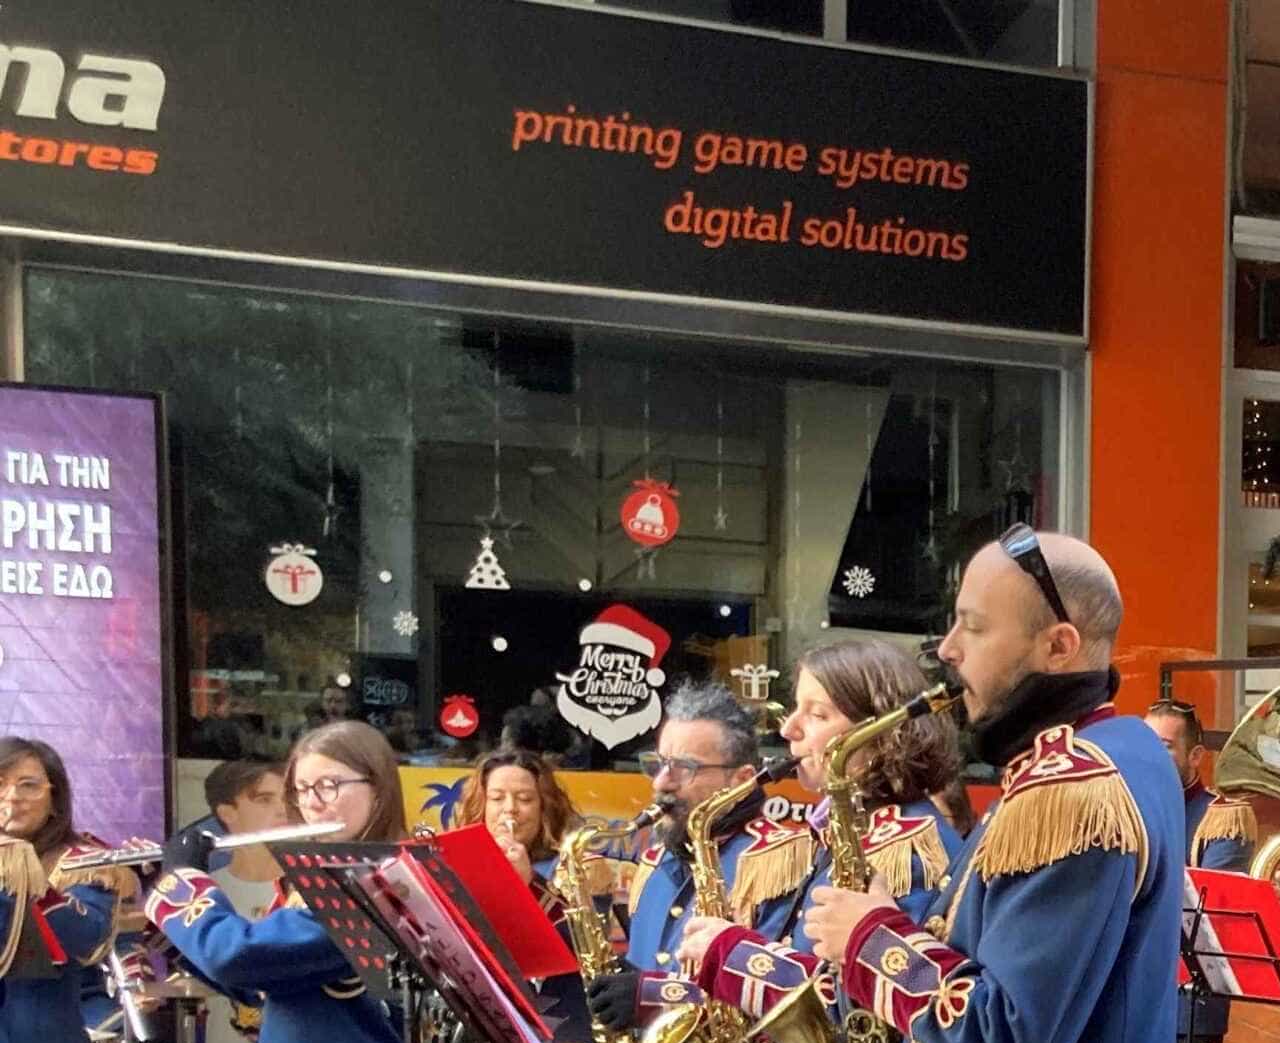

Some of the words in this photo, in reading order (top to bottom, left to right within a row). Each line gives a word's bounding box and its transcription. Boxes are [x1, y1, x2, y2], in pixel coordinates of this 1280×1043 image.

[511, 104, 682, 169] printing
[694, 132, 808, 174] game
[817, 147, 970, 190] systems
[801, 208, 970, 262] solutions
[6, 451, 49, 486] ΓΙΑ
[54, 454, 110, 490] ΤΗΝ
[2, 499, 112, 554] ΡΗΣΗ
[52, 563, 113, 599] ΕΔΩ
[580, 645, 645, 683] Merry
[556, 668, 649, 700] Christmas
